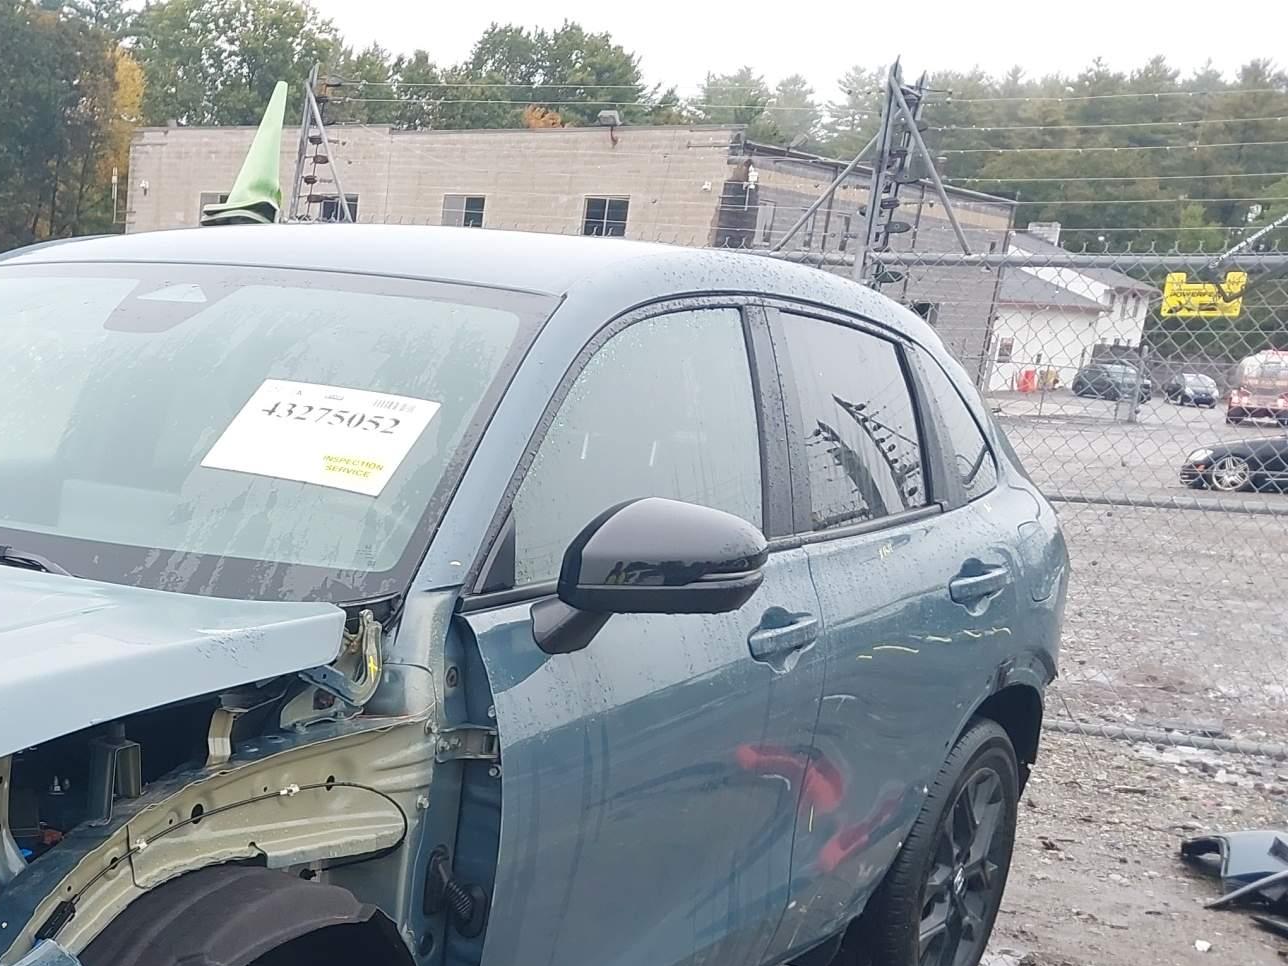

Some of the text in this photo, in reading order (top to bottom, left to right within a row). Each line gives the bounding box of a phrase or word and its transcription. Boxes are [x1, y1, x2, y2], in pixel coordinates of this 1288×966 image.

[261, 401, 401, 434] 43275052
[322, 454, 384, 471] INSPECTION
[325, 464, 370, 479] SERVICE
